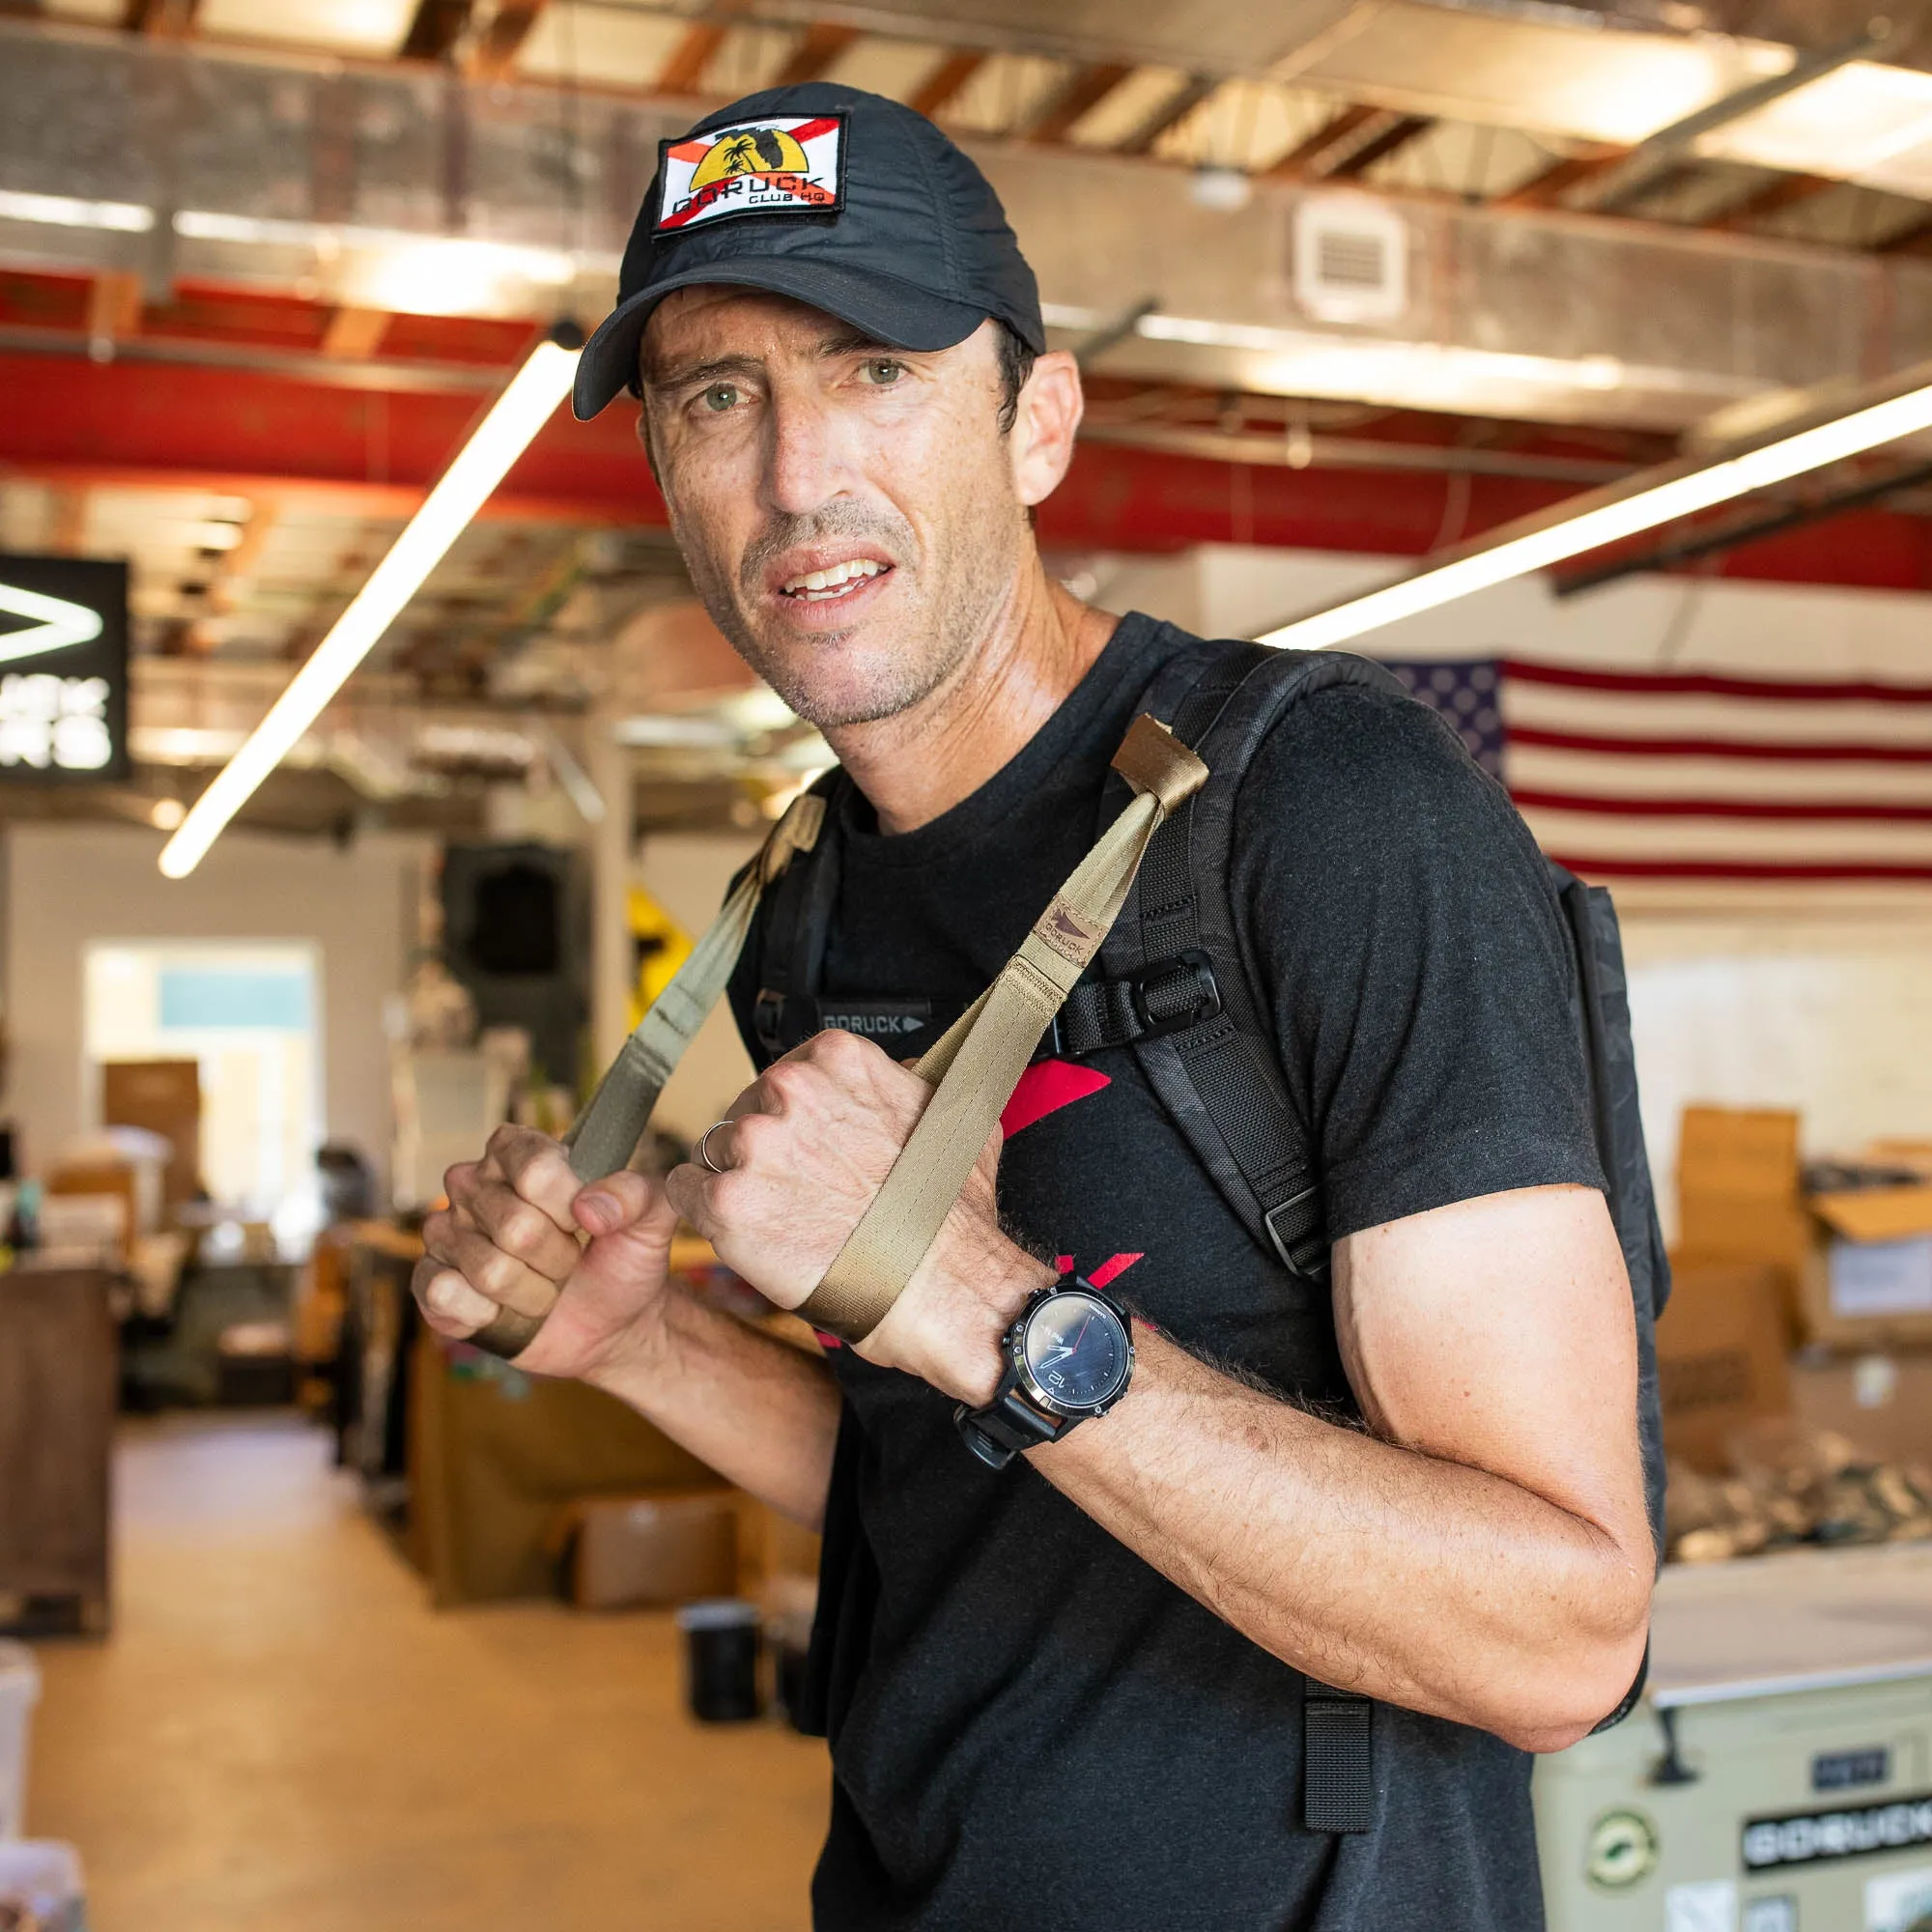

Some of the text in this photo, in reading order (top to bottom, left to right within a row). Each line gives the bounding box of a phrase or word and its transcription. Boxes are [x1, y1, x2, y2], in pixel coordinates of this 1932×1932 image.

[671, 177, 825, 214] GORUCK
[748, 192, 825, 204] CLUB HQ
[1044, 922, 1085, 954] GORUCK
[823, 1015, 902, 1033] GORUCK
